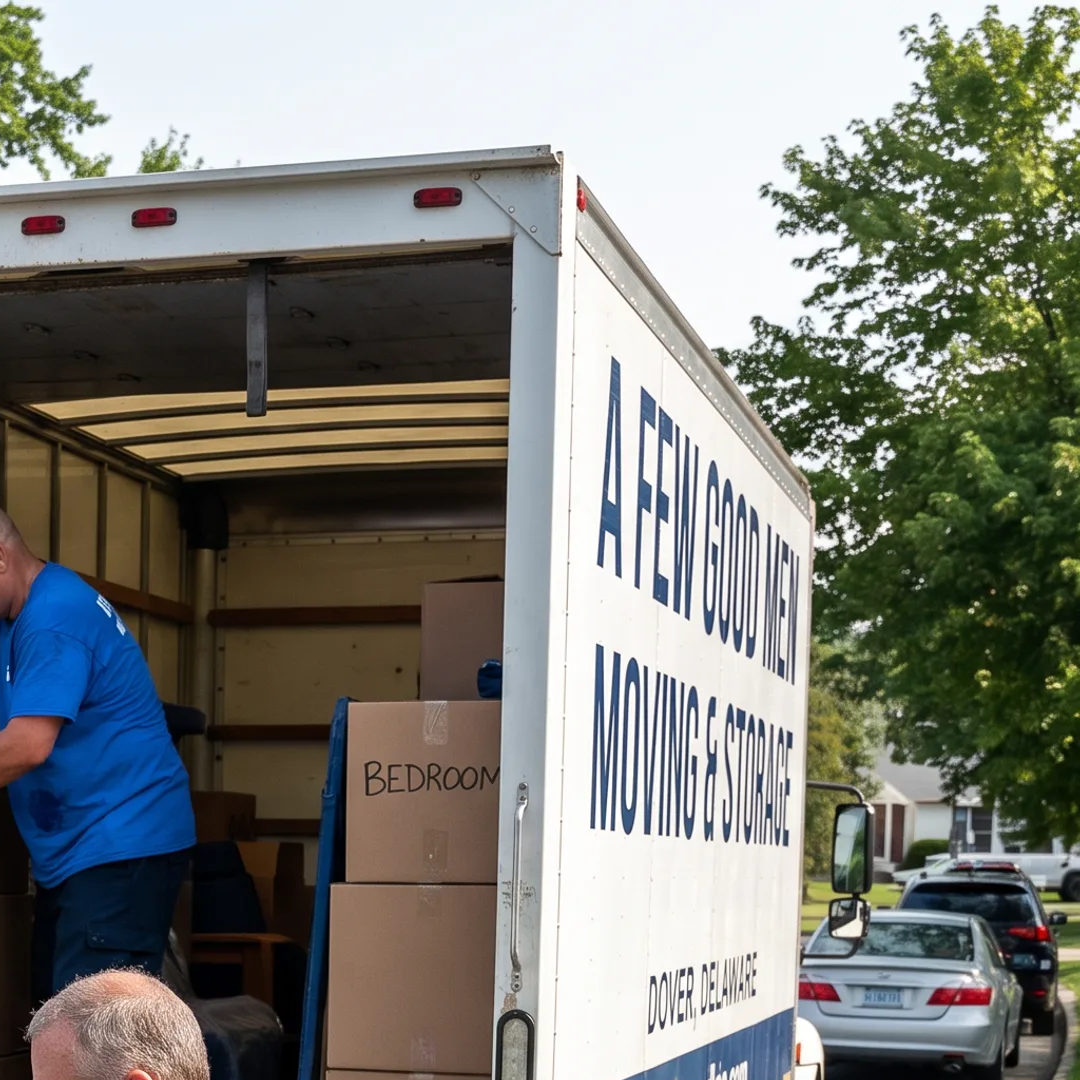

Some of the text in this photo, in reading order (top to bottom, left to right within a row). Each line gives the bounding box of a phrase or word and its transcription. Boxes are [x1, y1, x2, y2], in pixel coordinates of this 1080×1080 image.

[597, 356, 800, 685] A FEW GOOD MEN
[364, 760, 500, 796] BEDROOM
[590, 644, 793, 847] MOVING & STORAGE
[648, 951, 757, 1035] DOVER, DELAWARE
